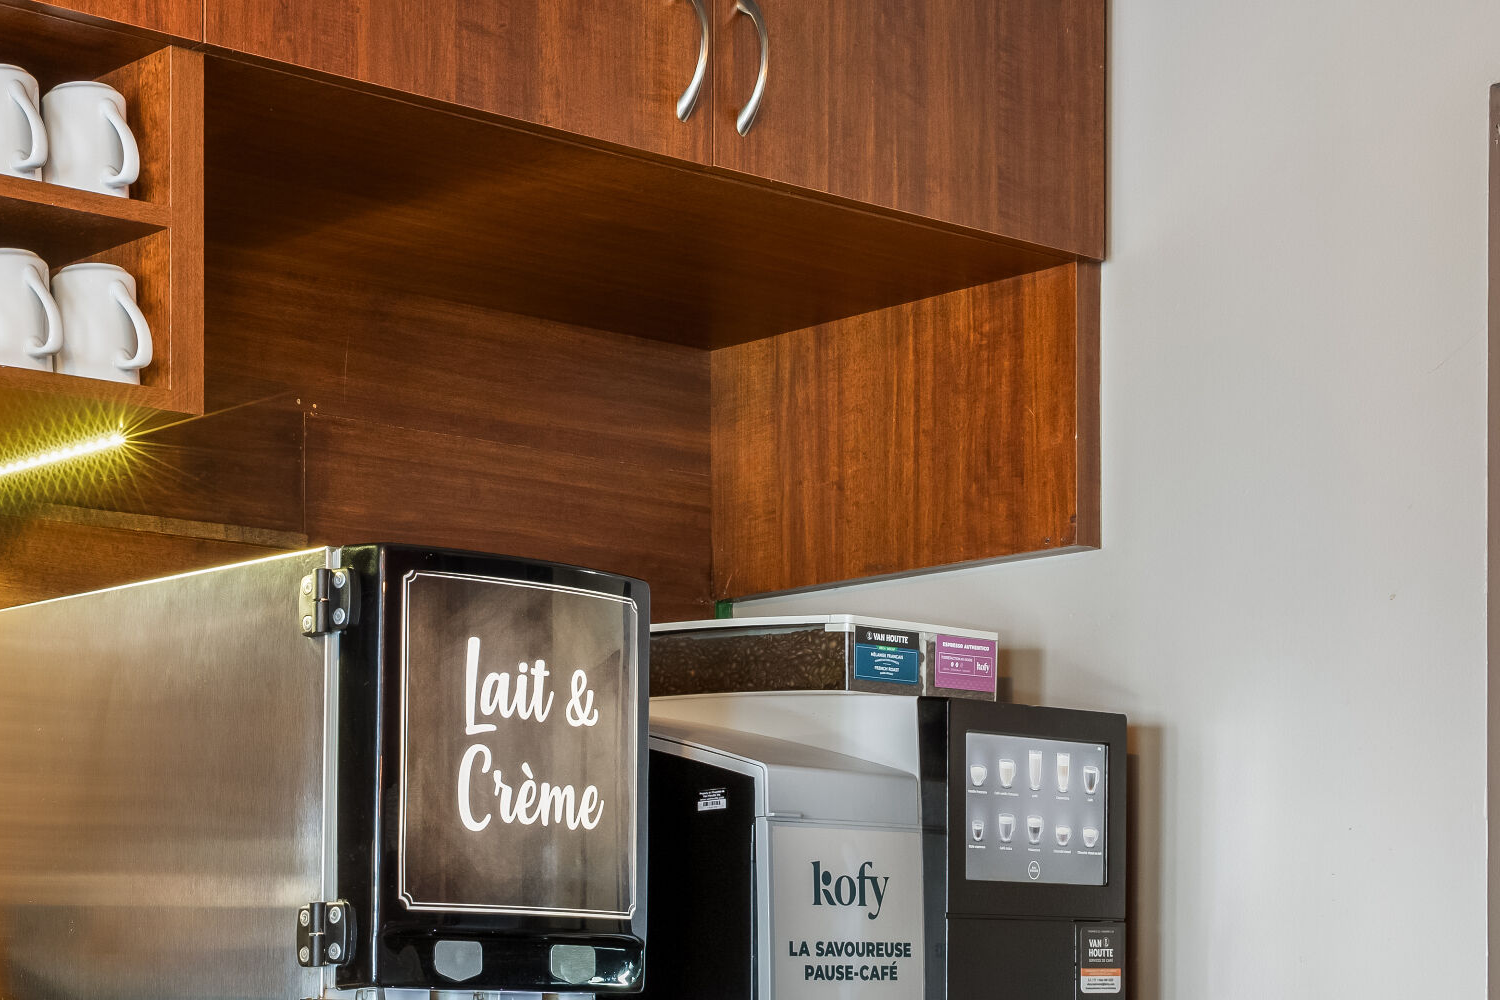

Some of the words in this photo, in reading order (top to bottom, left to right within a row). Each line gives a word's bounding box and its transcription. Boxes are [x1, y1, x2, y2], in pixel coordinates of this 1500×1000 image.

[873, 632, 885, 641] VAN
[886, 634, 909, 644] HOUTTE
[465, 637, 555, 736] Lait
[565, 669, 599, 727] &
[458, 744, 604, 832] Crème
[811, 861, 890, 920] kofy
[789, 941, 810, 957] LA
[815, 941, 911, 958] SAVOUREUSE
[1088, 938, 1102, 948] VAN
[1088, 948, 1114, 957] HOUTTE
[804, 961, 898, 981] PAUSE-CAFÉ
